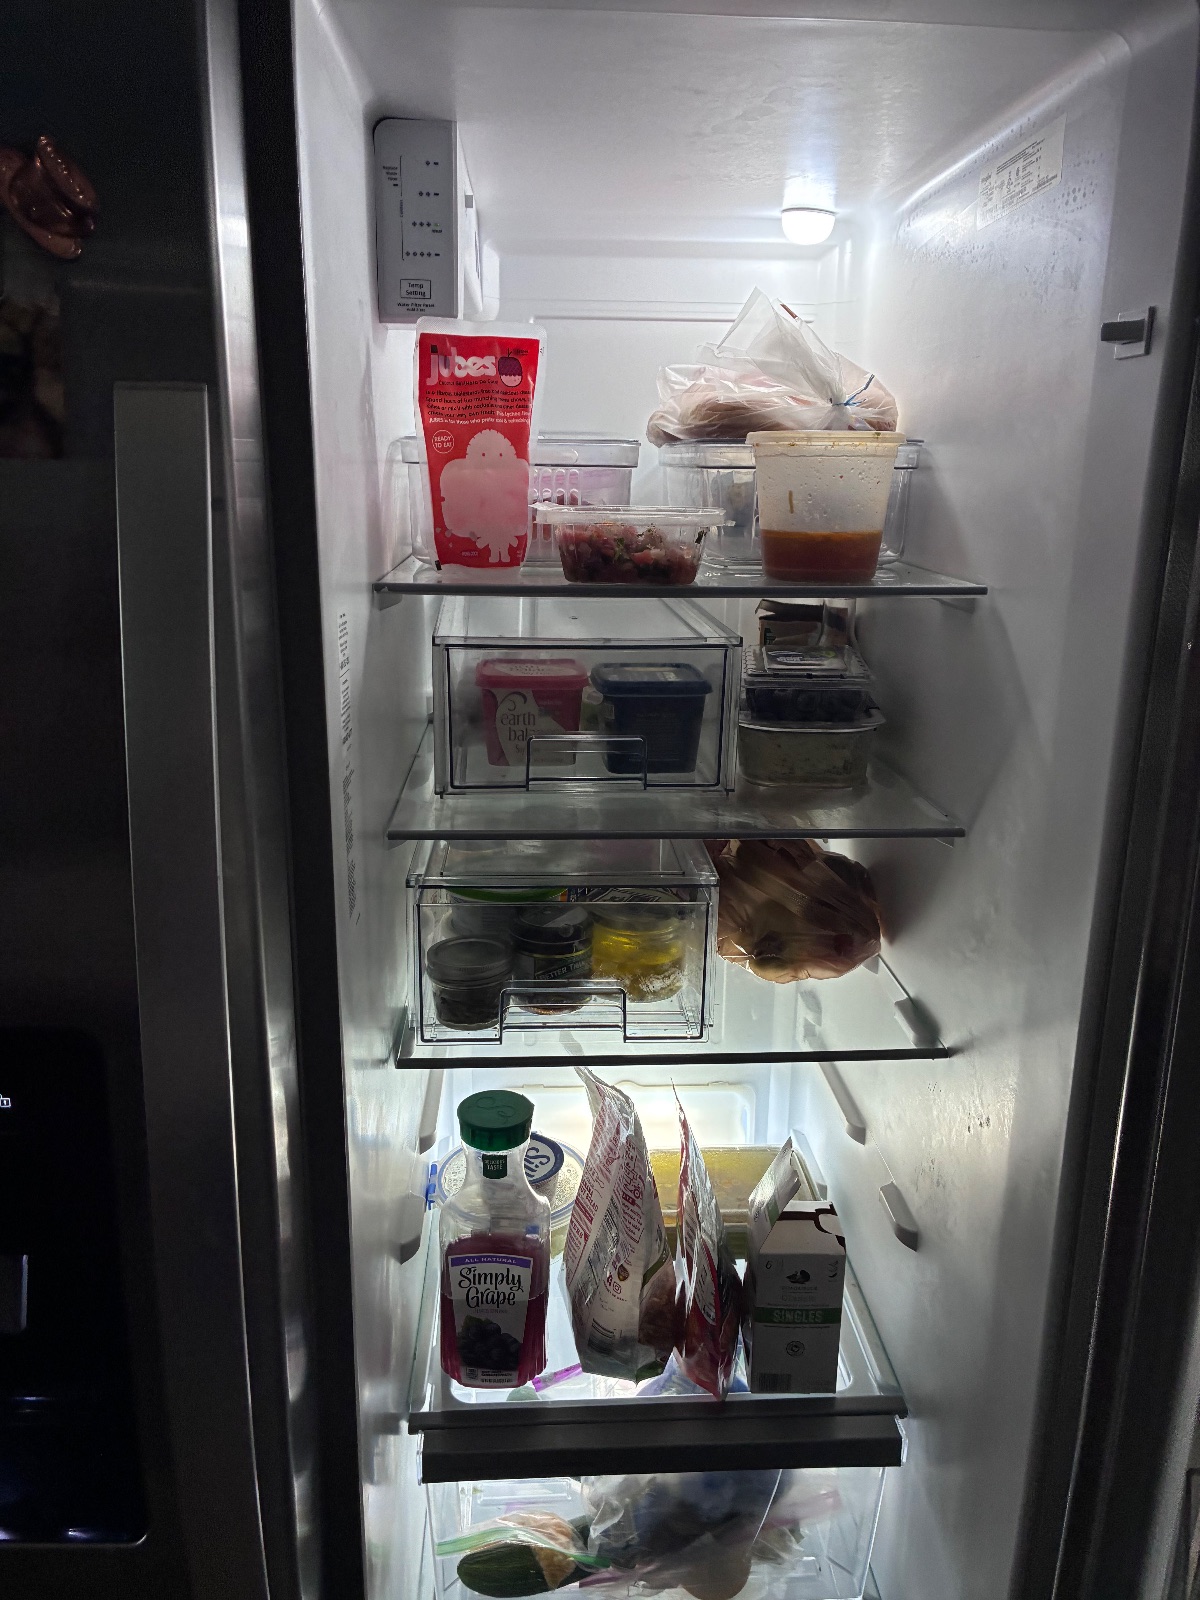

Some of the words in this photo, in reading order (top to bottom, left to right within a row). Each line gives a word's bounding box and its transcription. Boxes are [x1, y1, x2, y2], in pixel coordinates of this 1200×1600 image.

[405, 290, 426, 298] Setting
[501, 711, 536, 726] earth
[486, 1163, 503, 1171] TASTE
[458, 1266, 524, 1292] Simply
[465, 1286, 516, 1308] Grape
